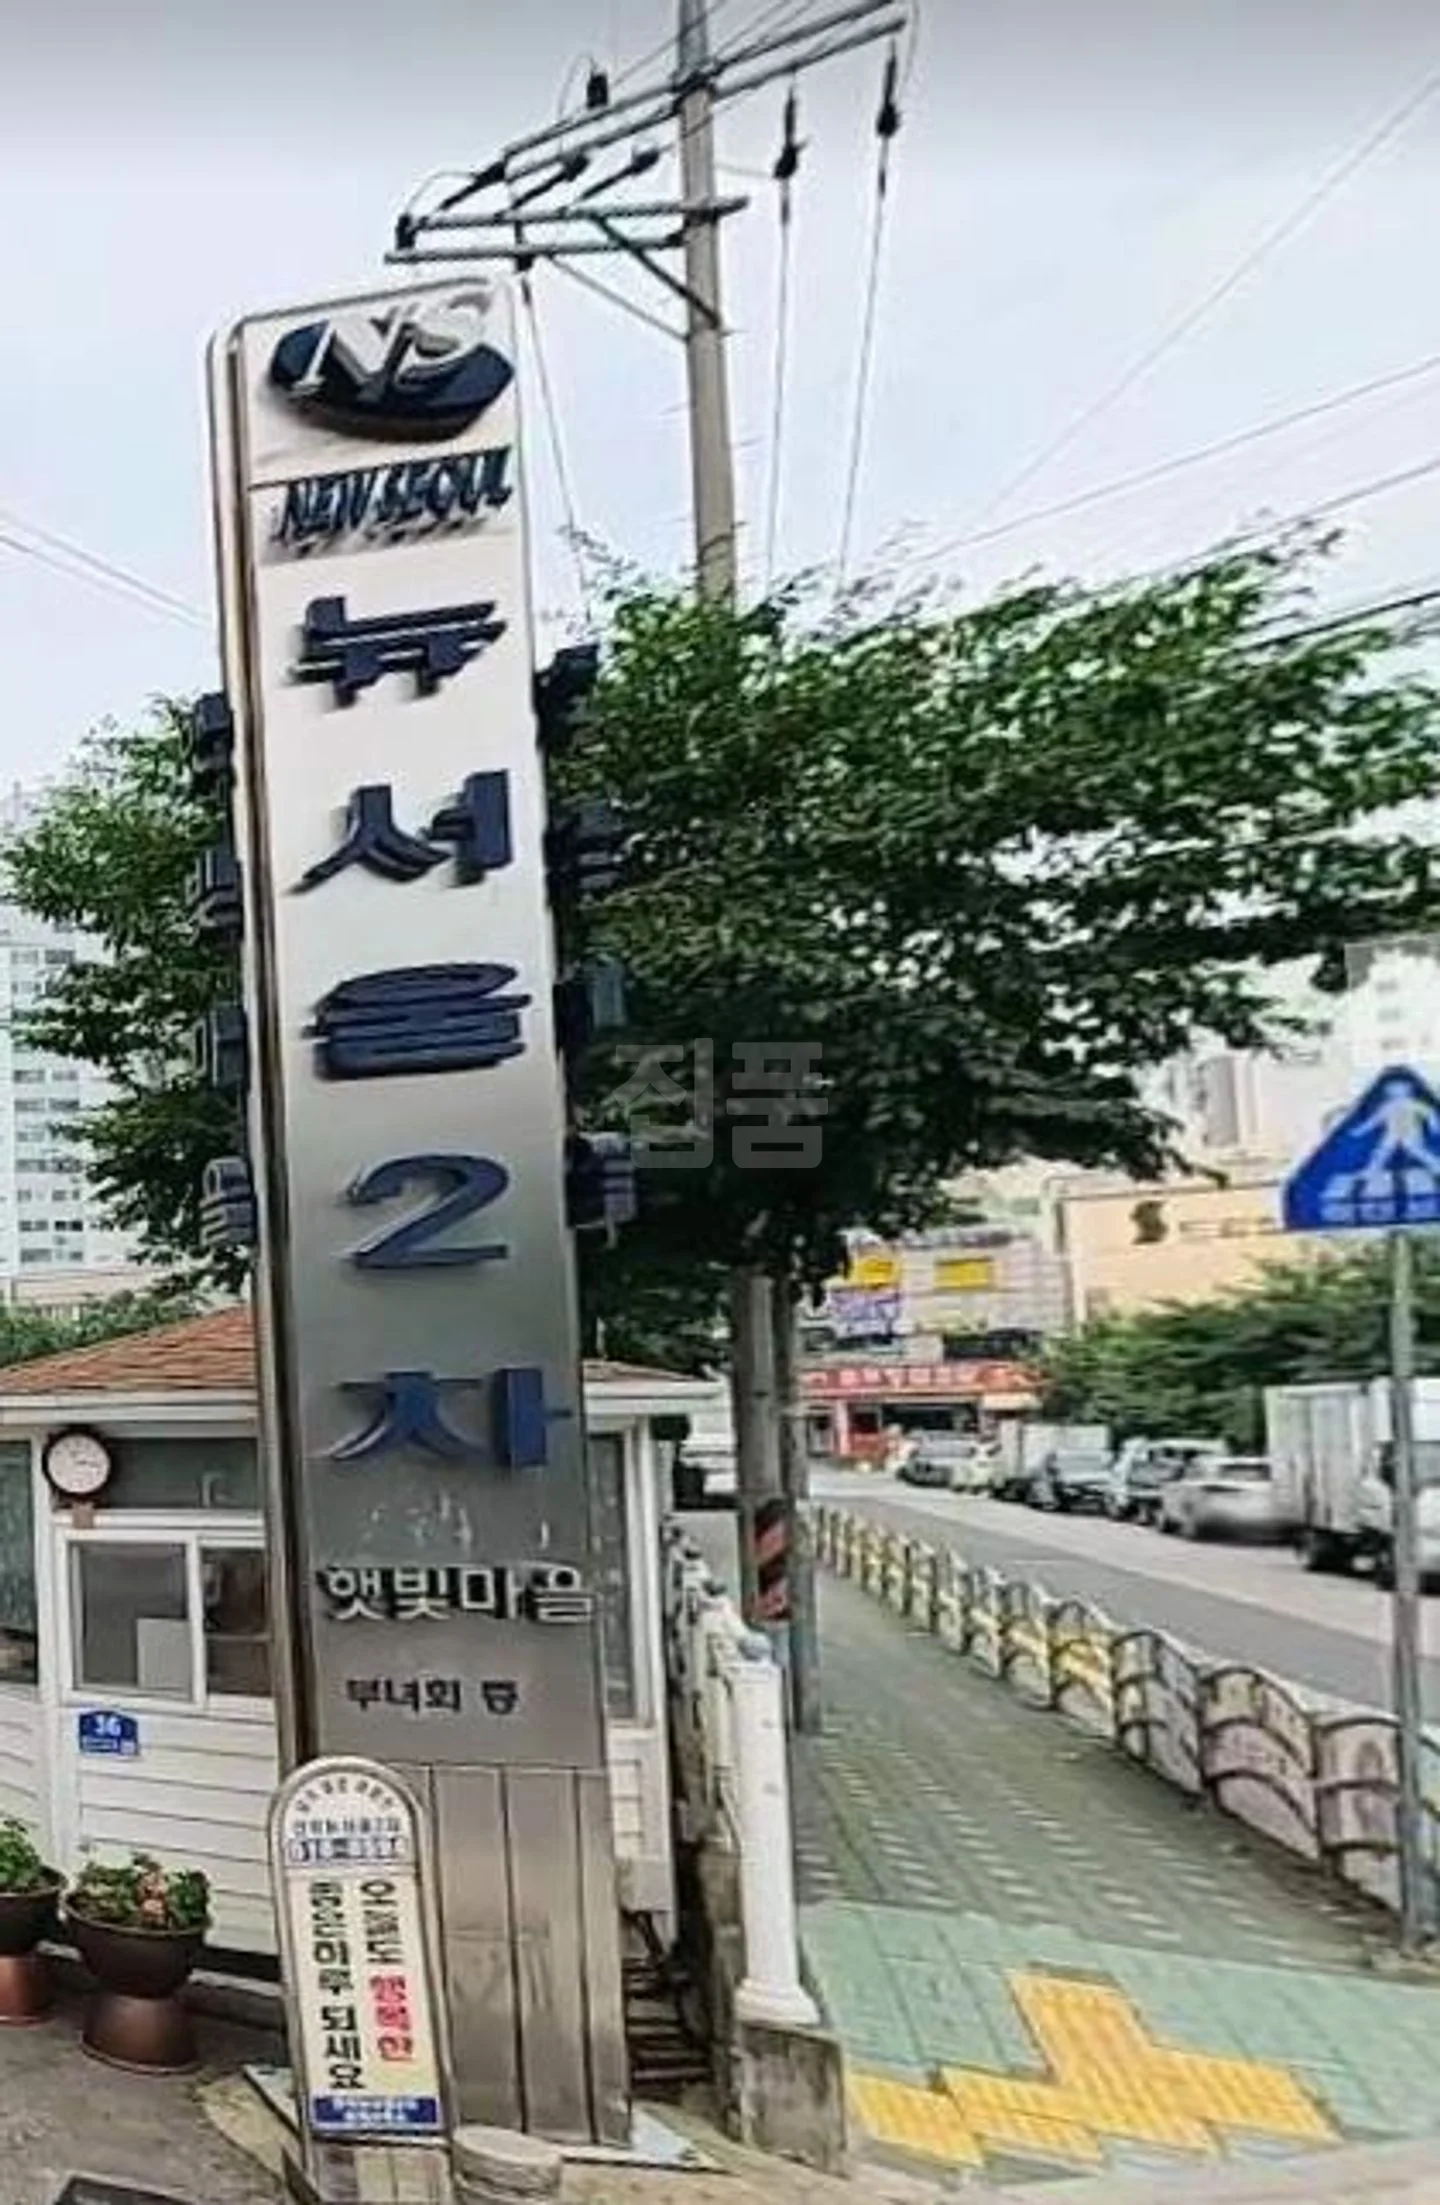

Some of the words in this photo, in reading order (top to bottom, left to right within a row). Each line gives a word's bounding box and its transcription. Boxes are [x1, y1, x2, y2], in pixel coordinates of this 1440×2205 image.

[290, 293, 494, 396] NS
[322, 1564, 595, 1625] 햇빛마을
[347, 1677, 461, 1713] 부녀회
